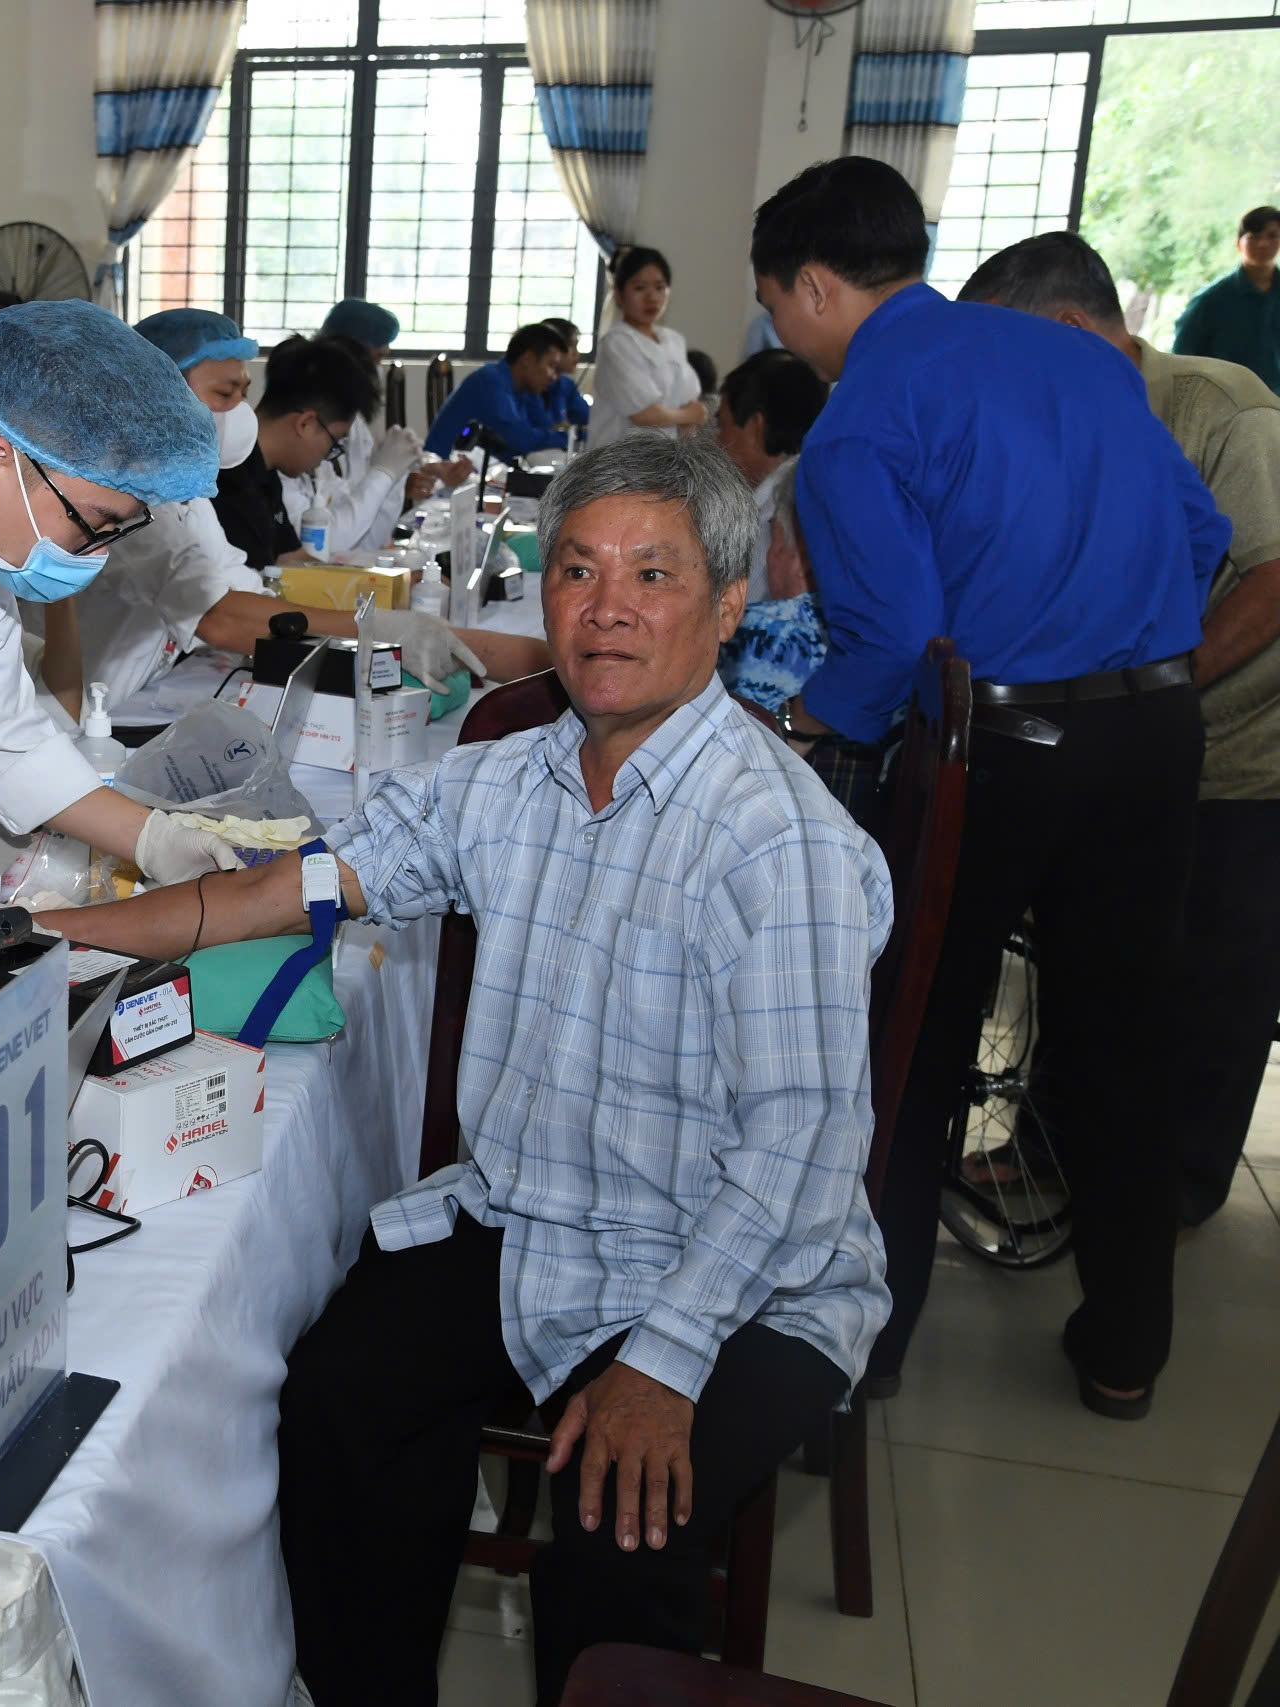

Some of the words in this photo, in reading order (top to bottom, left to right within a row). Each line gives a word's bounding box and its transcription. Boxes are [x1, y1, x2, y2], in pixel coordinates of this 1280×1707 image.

[126, 991, 158, 1010] GENEVIET
[181, 1119, 228, 1141] HANEL
[181, 1128, 228, 1148] COMMUNICATION
[12, 1270, 43, 1329] VỰC
[30, 1308, 61, 1372] ADN
